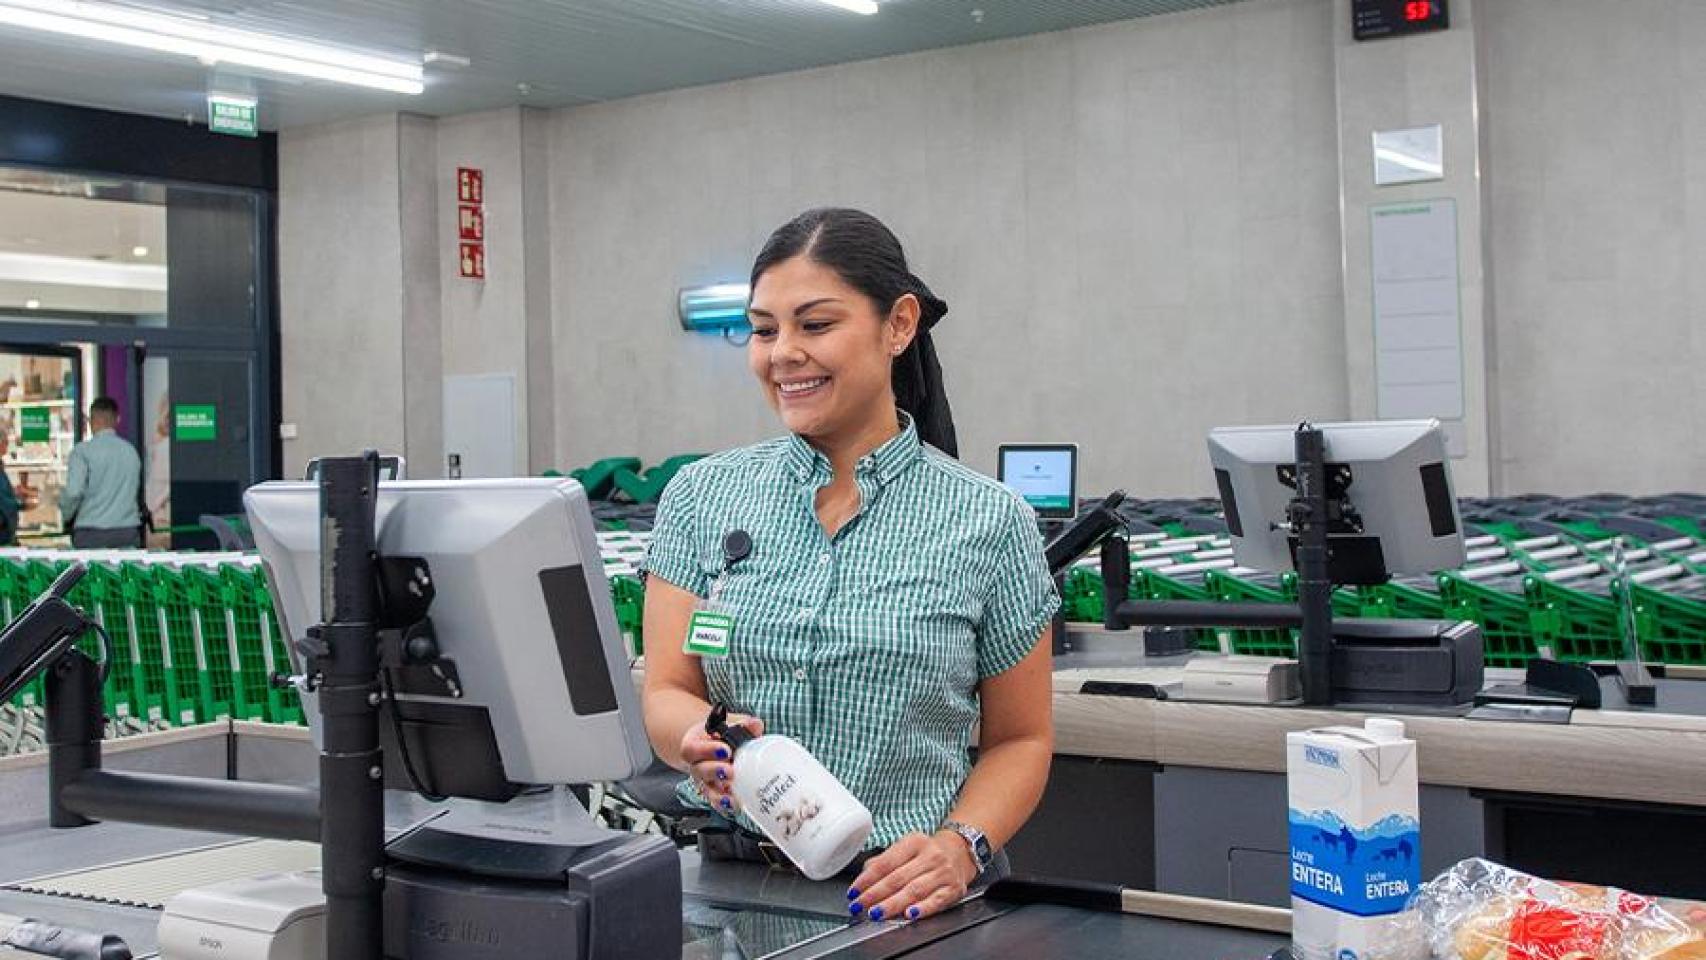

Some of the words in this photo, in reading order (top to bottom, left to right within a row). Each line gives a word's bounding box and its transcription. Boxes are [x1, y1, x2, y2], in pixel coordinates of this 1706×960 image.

[760, 775, 797, 815] Protect
[1292, 846, 1314, 865] Leche
[1292, 862, 1344, 897] ENTERA
[1366, 880, 1410, 900] ENTERA
